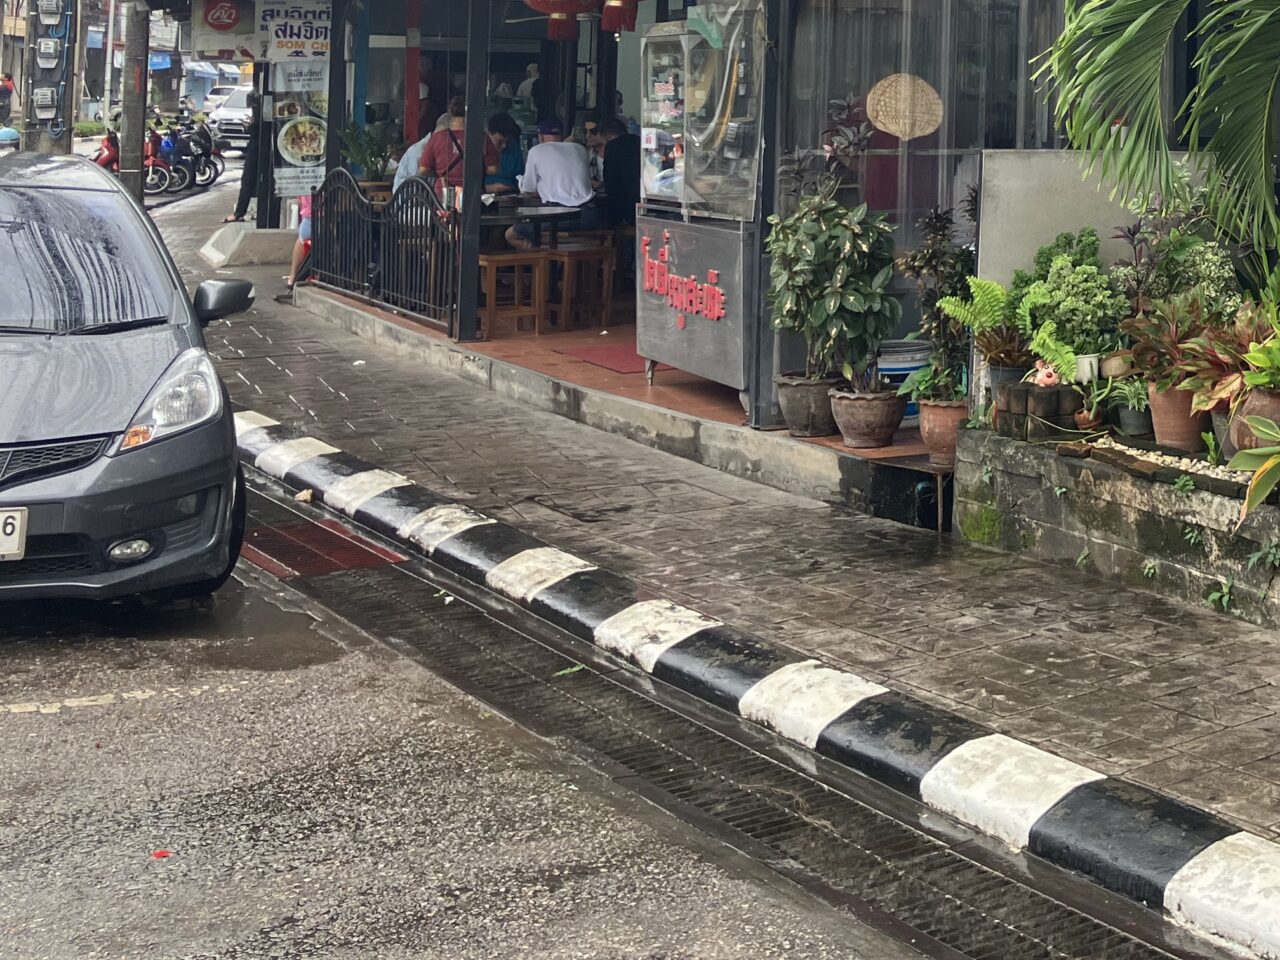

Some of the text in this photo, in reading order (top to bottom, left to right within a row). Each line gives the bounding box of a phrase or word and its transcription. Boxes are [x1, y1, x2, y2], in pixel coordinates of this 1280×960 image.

[274, 21, 331, 40] สมจิต
[276, 41, 306, 50] SOM
[311, 42, 329, 51] CH
[2, 515, 17, 537] 6
